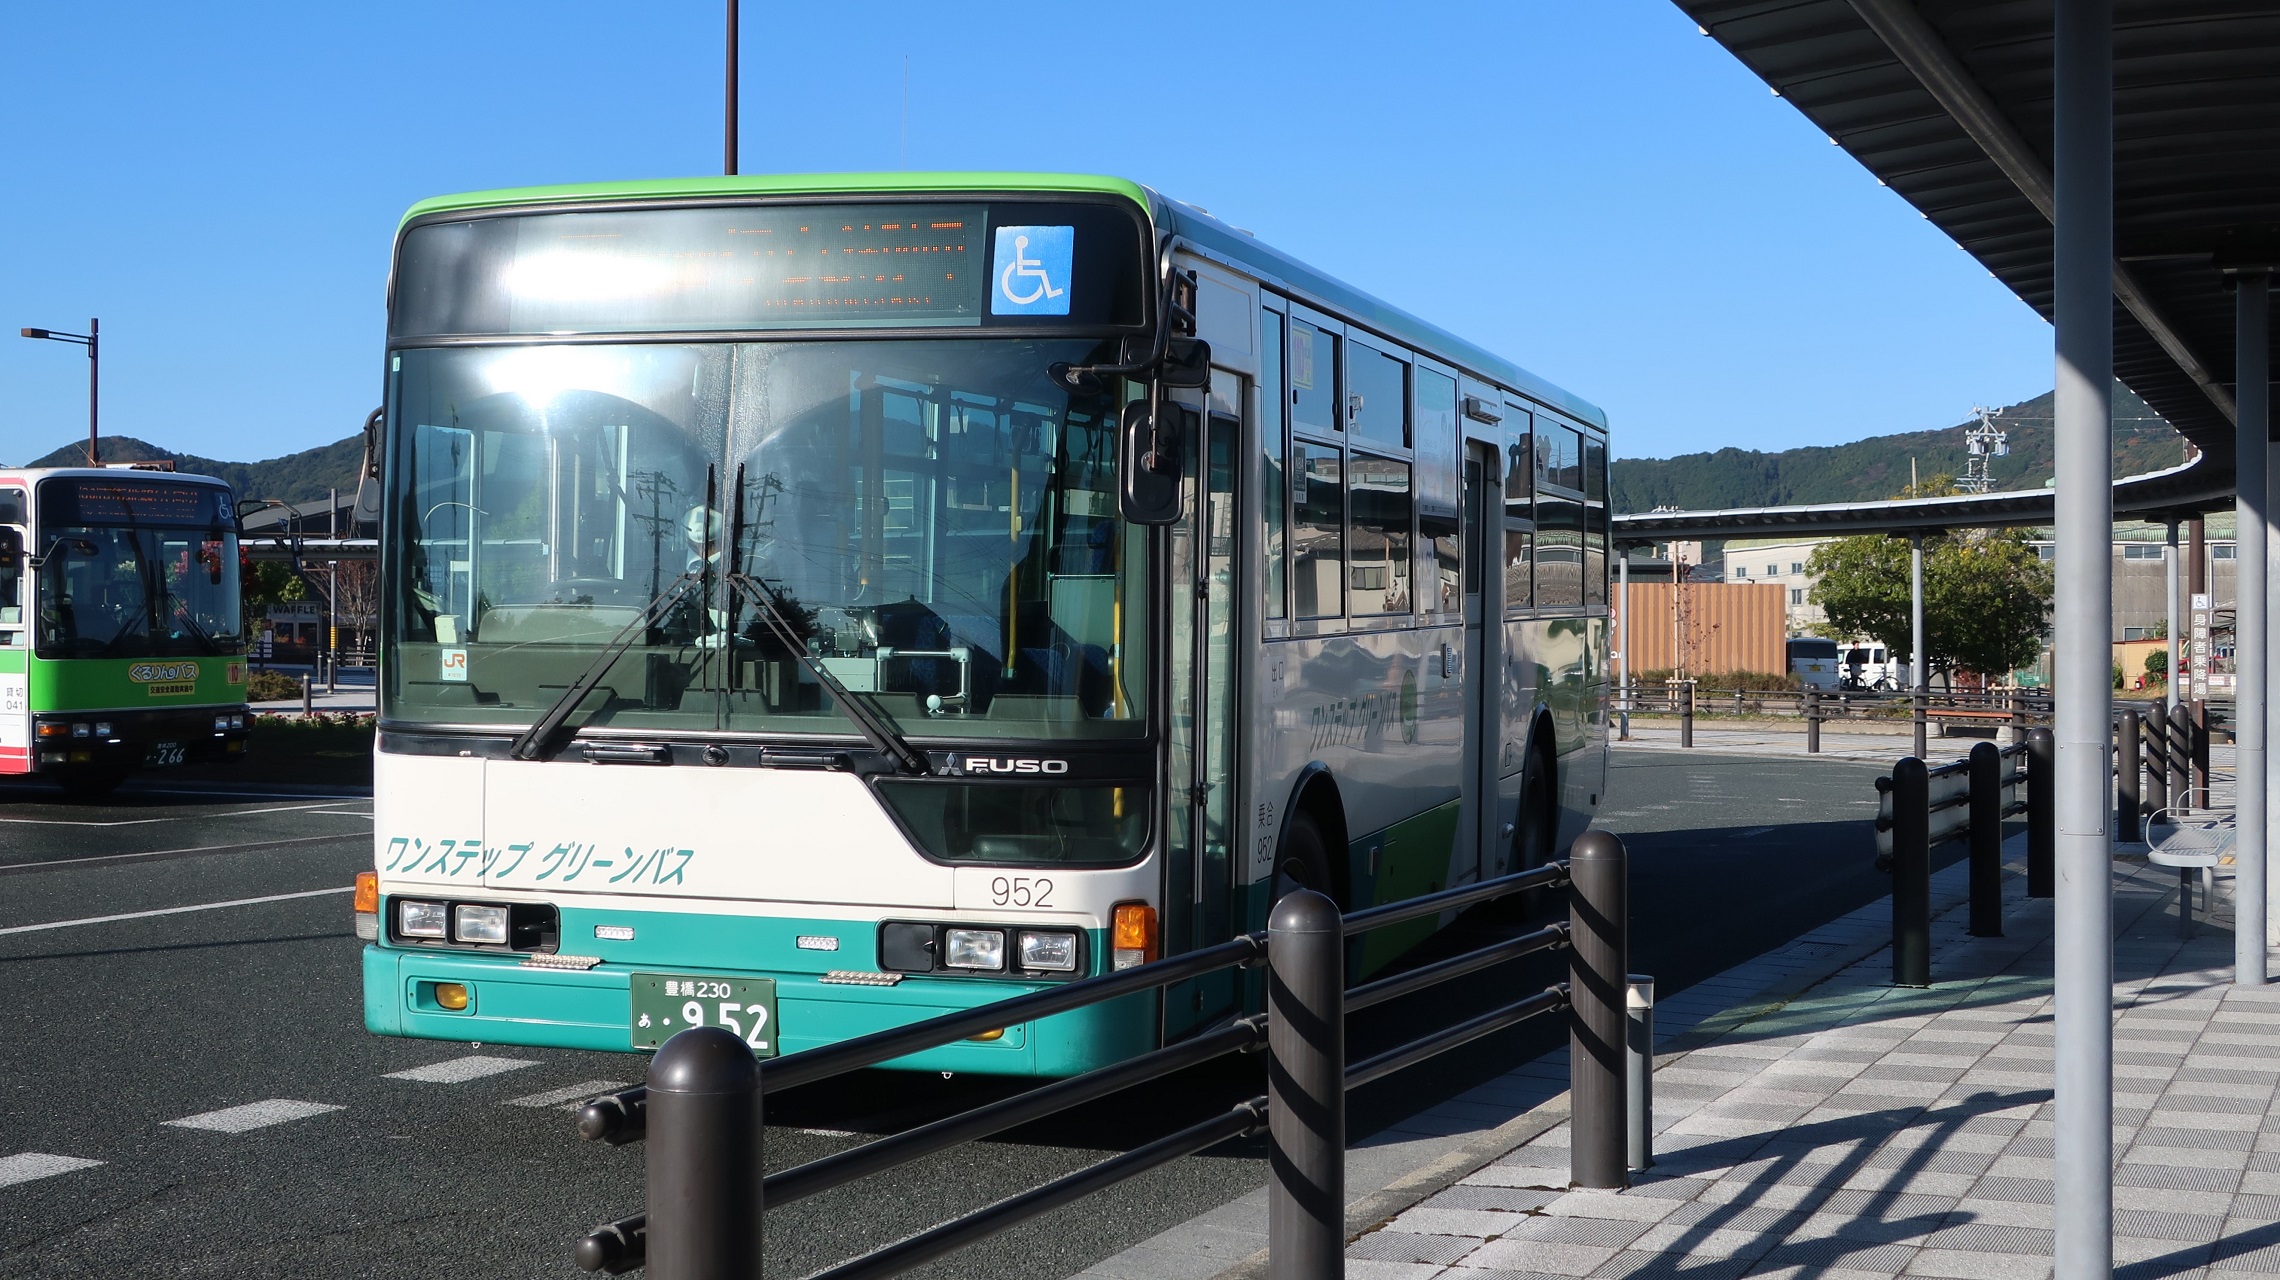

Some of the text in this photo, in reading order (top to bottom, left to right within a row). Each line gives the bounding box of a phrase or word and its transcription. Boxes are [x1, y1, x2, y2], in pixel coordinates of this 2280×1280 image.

[444, 653, 465, 669] JR
[2193, 613, 2207, 695] 身障者乗降場
[131, 664, 197, 681] ぐるりんバス
[6, 700, 23, 711] 041
[965, 758, 1069, 774] FUSO
[1258, 801, 1273, 829] 乗合
[1257, 835, 1273, 863] 952
[386, 837, 695, 886] ワンステップ グリーンバス
[991, 876, 1054, 908] 952
[664, 980, 731, 999] 豊橋230
[637, 1012, 651, 1029] あ
